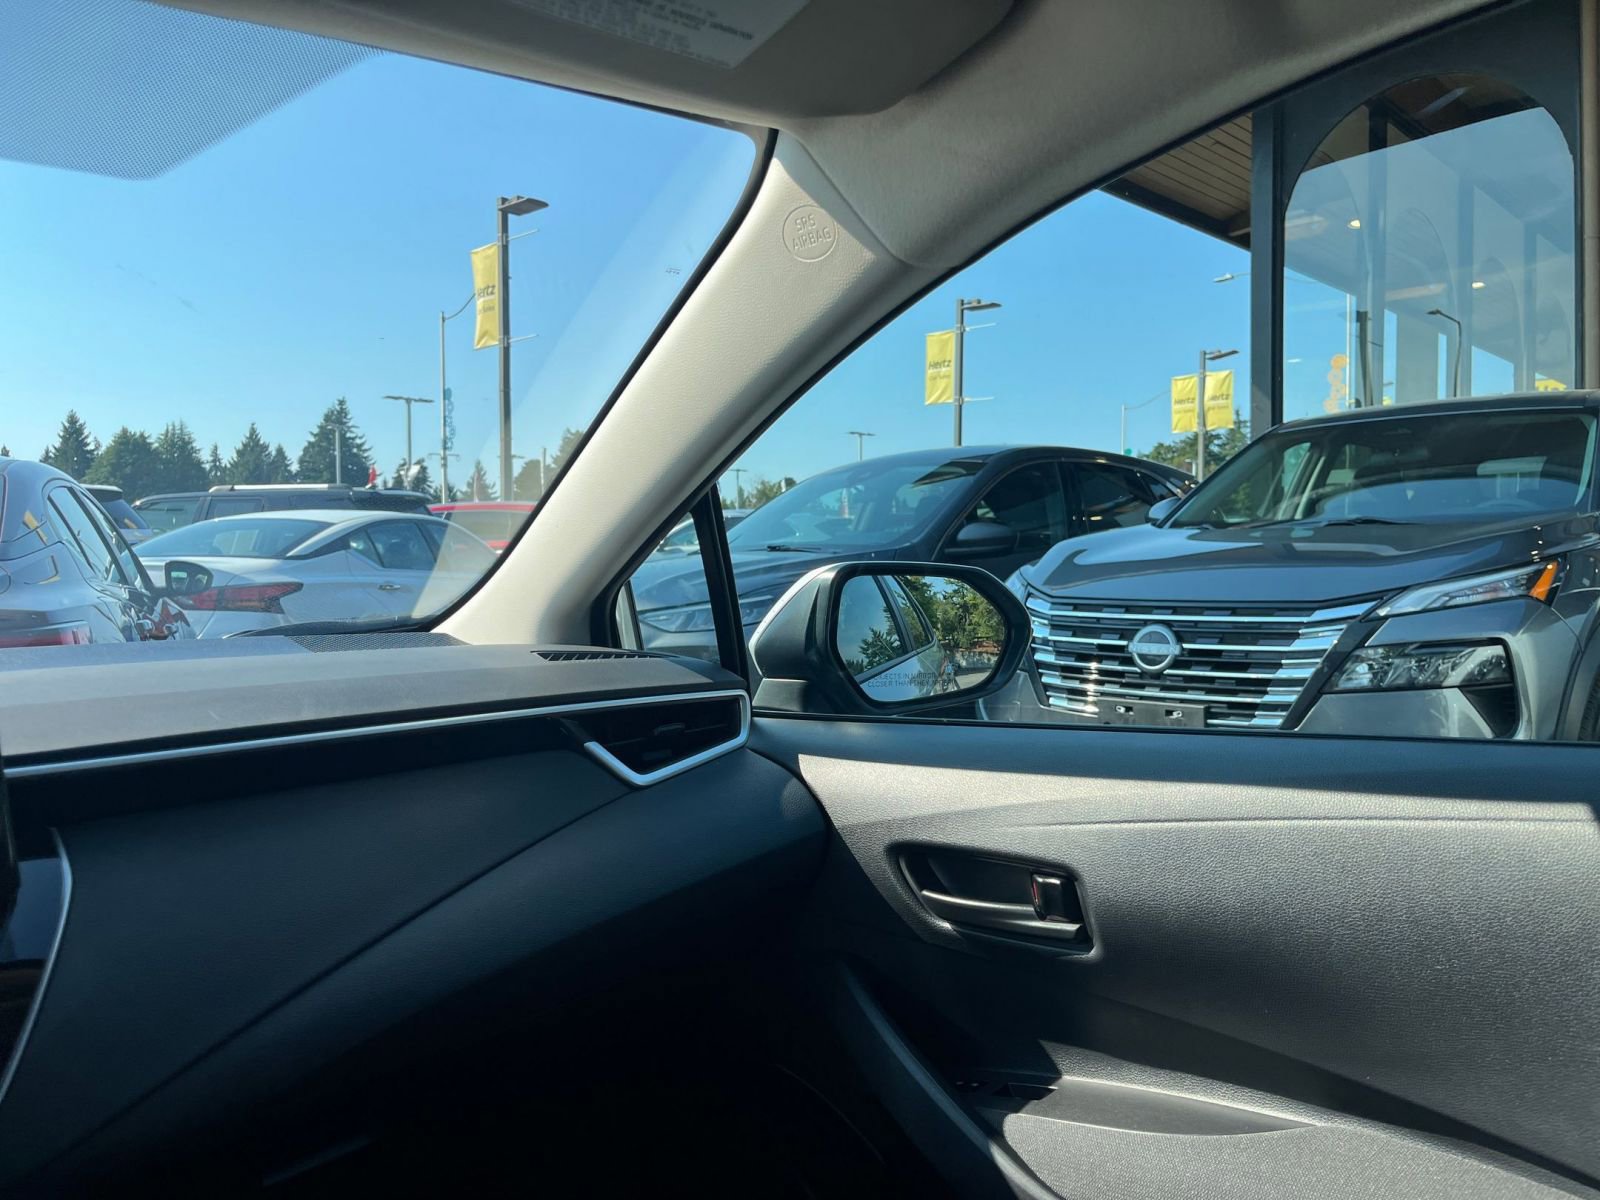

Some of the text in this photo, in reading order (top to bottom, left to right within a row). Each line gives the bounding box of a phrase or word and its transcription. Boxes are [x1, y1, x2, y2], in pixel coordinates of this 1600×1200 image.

[794, 213, 817, 234] SRS
[792, 226, 833, 251] AIRBAG
[928, 358, 952, 371] Hertz
[867, 680, 893, 688] CLOSER
